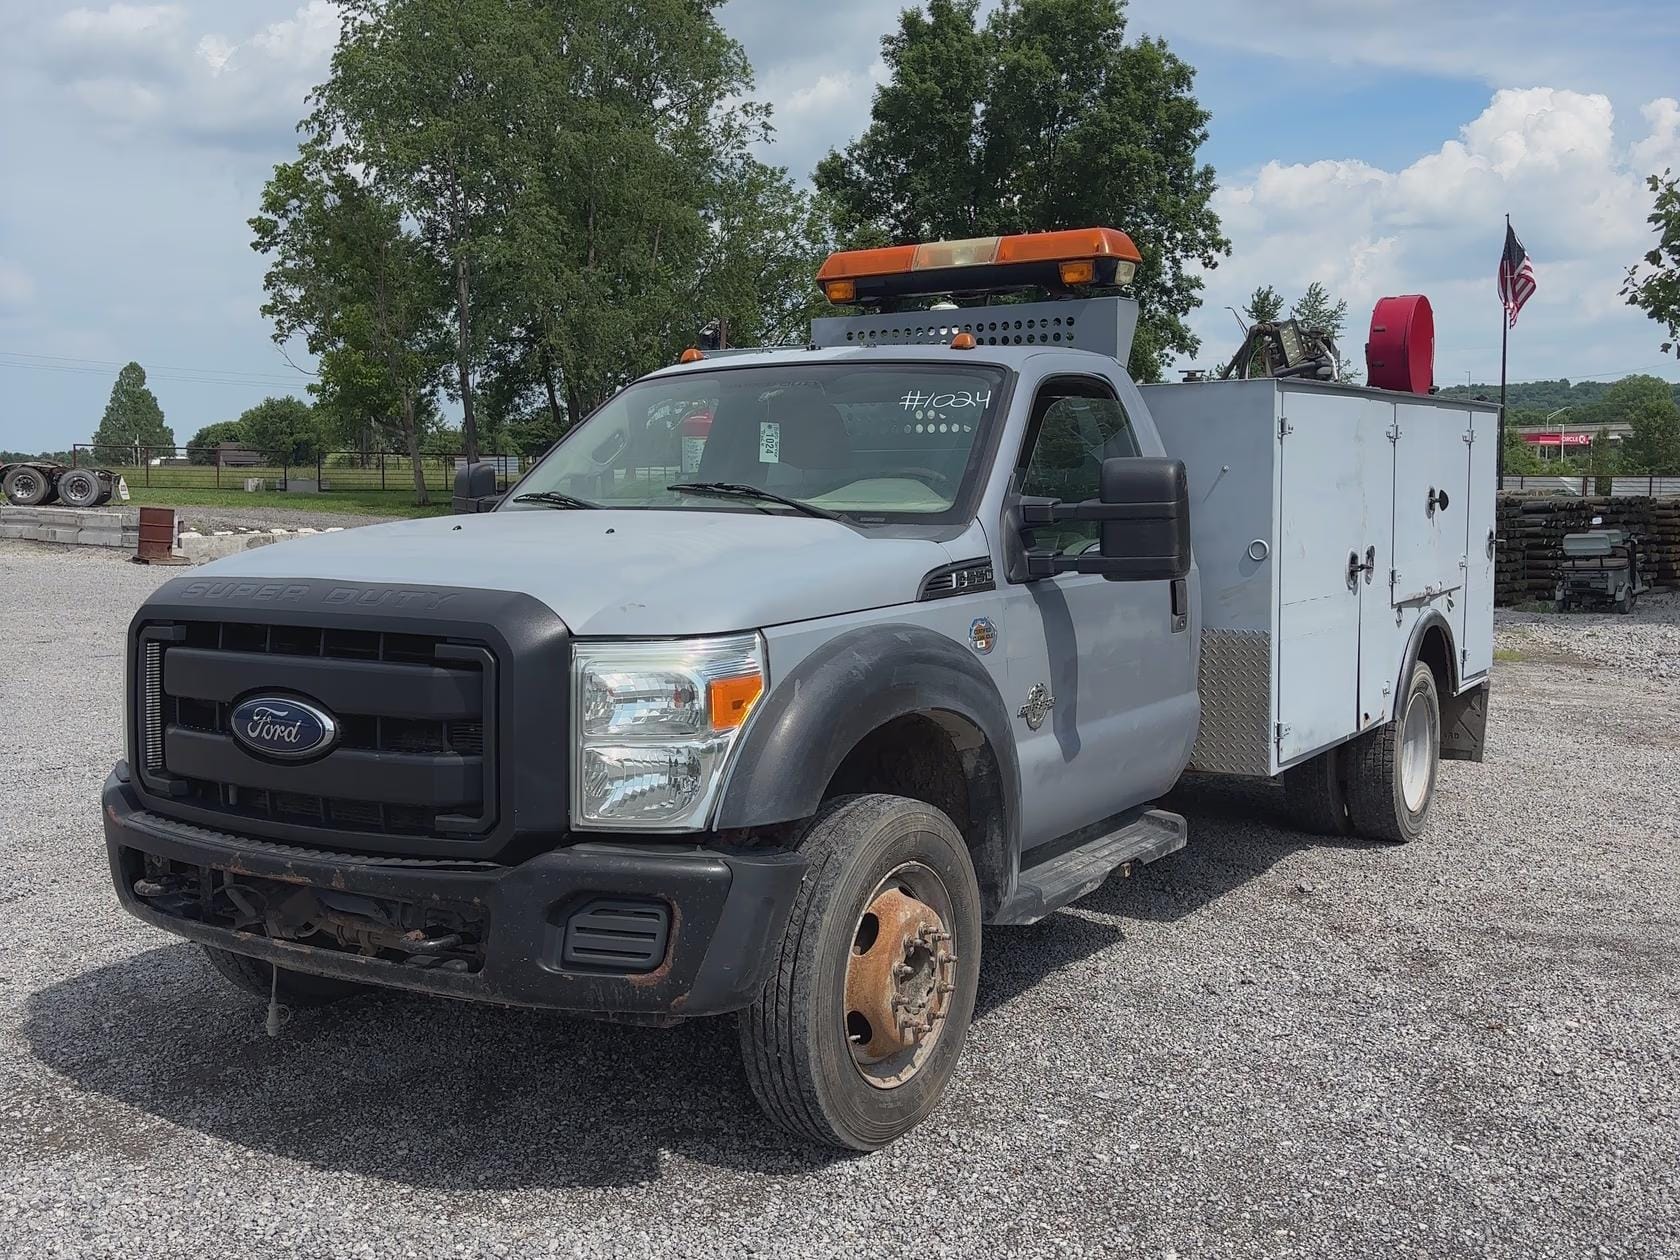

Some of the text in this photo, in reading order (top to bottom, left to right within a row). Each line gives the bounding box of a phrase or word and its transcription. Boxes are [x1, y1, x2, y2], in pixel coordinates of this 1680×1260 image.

[899, 390, 991, 411] #1024
[765, 433, 775, 454] 1024
[181, 582, 459, 610] SUPER DUTY
[247, 706, 301, 743] Ford
